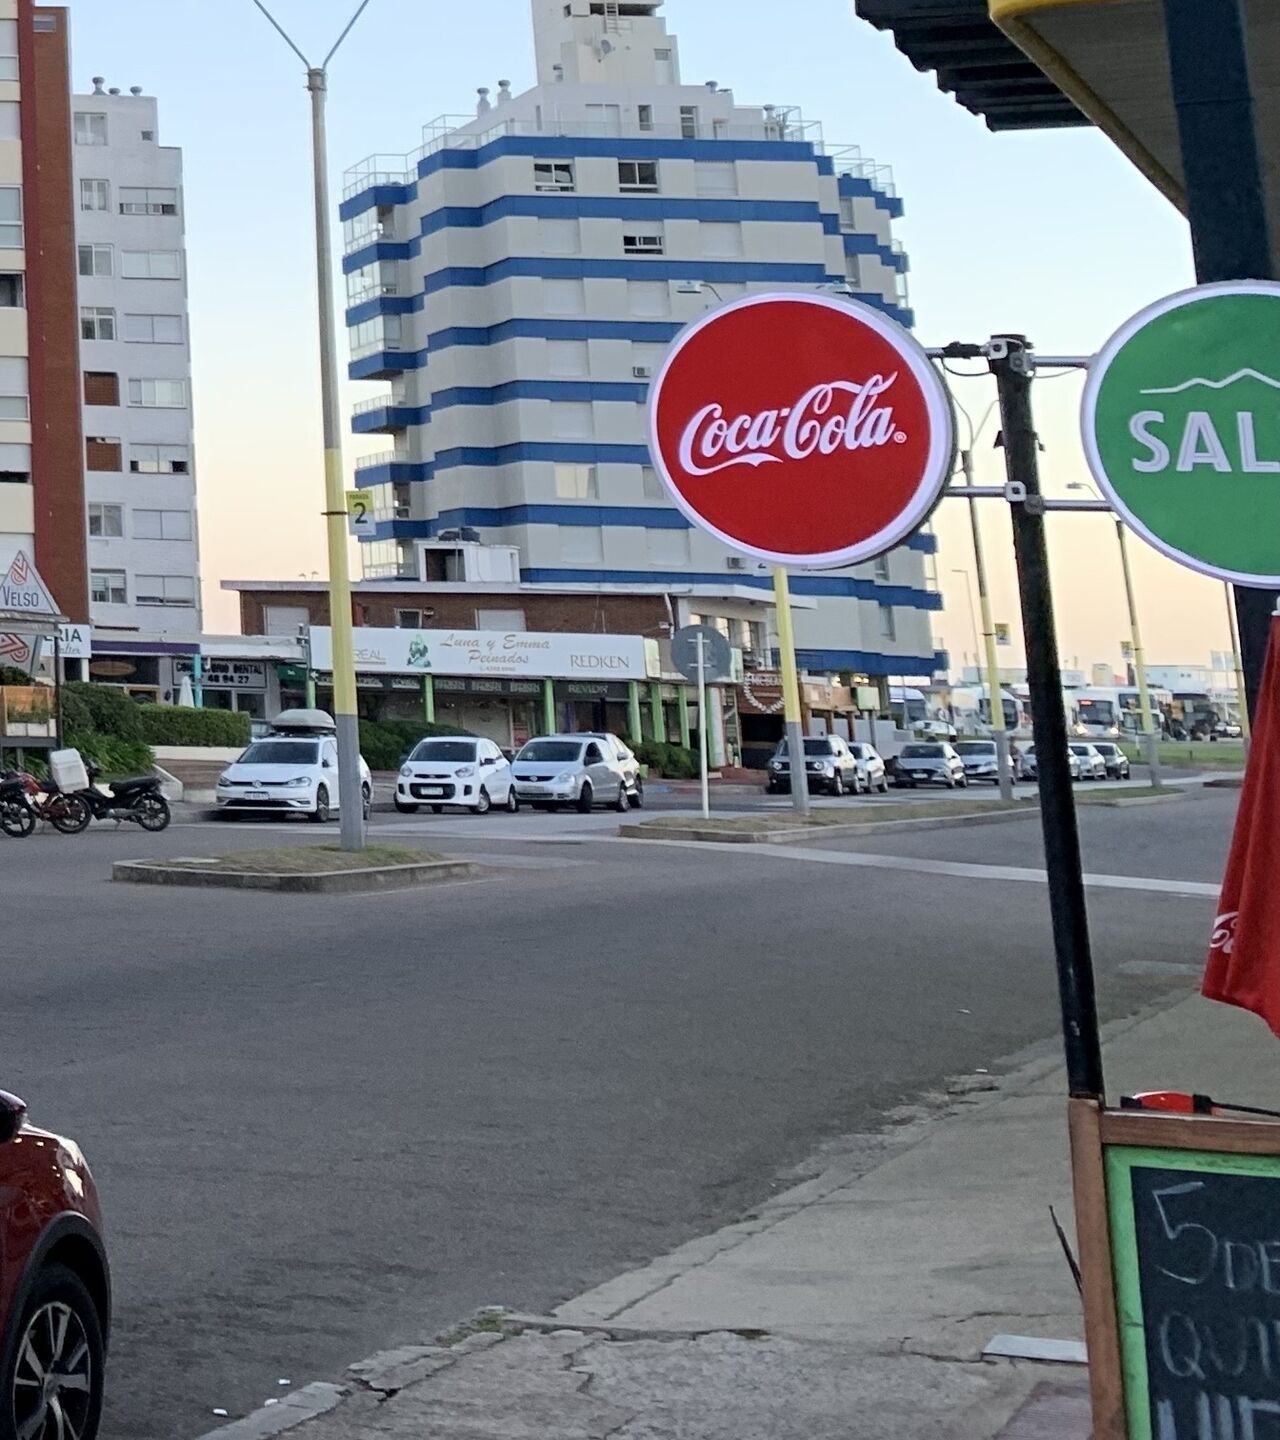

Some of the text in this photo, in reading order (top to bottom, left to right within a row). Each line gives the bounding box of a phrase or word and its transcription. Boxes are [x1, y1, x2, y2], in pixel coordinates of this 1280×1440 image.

[677, 370, 899, 477] Coca-Cola
[353, 501, 368, 524] 2
[2, 585, 39, 608] VELSO
[440, 633, 551, 650] Luna y Emma
[468, 648, 529, 665] Peinados
[570, 654, 630, 669] REDKEN
[233, 663, 263, 675] DENTAL
[238, 675, 250, 684] 27
[1152, 1180, 1218, 1285] 5
[1159, 1310, 1280, 1380] QUI
